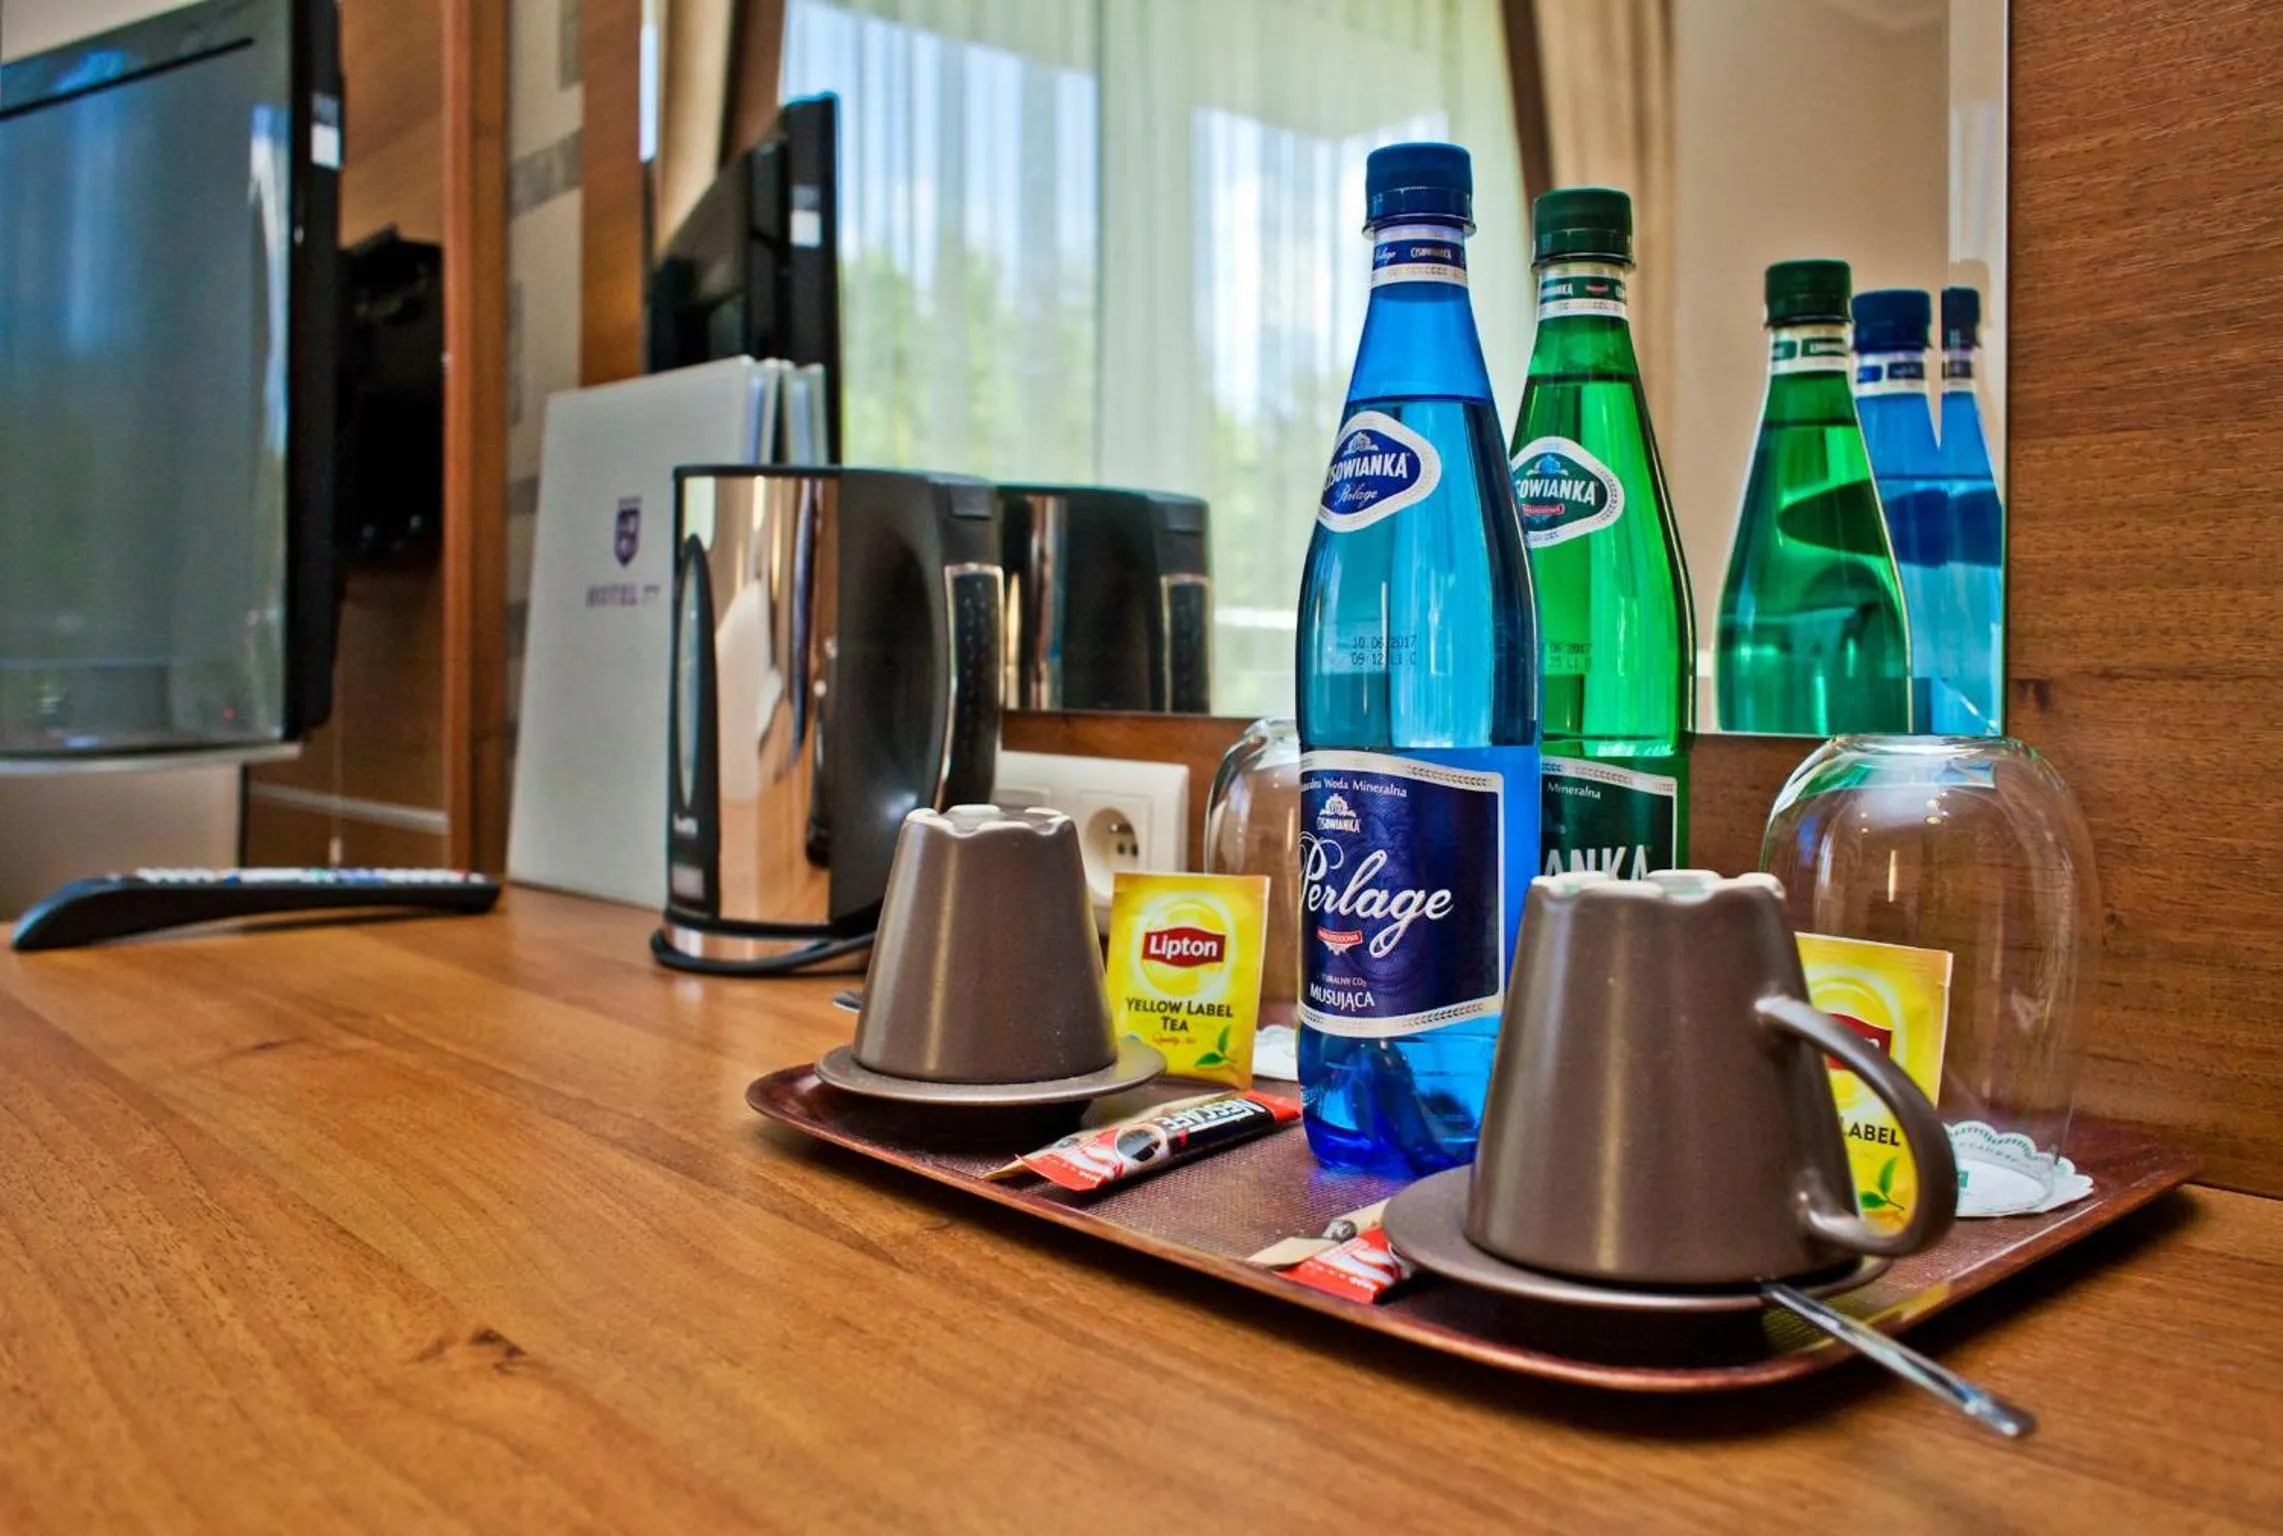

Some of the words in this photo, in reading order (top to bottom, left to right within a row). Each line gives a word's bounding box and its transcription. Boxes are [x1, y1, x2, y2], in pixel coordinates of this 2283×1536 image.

[1352, 780, 1408, 798] Mineralna
[1547, 782, 1601, 799] Mineralna
[1299, 831, 1454, 959] Perlage
[1149, 934, 1218, 960] Lipton
[1126, 997, 1182, 1014] YELLOW
[1186, 1000, 1234, 1018] LABEL
[1310, 982, 1375, 1013] MUSUJĄCA
[1161, 1016, 1189, 1032] TEA
